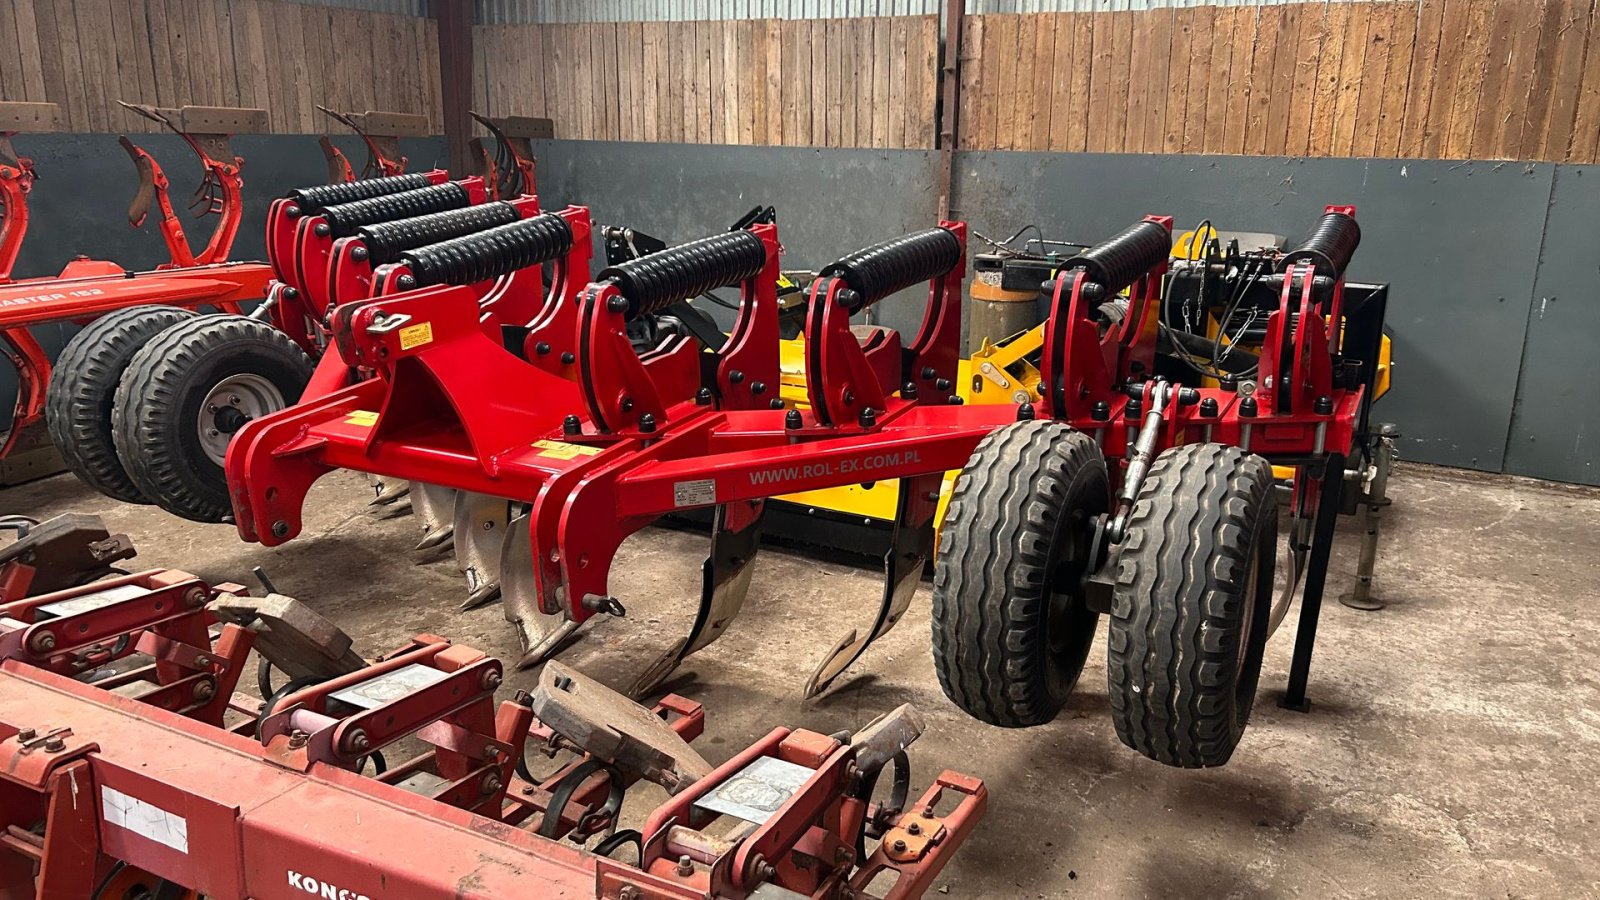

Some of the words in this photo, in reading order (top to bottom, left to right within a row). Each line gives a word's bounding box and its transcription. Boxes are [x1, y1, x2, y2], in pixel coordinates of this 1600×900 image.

[0, 293, 66, 307] ASTER
[69, 288, 105, 297] 152
[749, 451, 921, 485] WWW.ROL-EX.COM.PL
